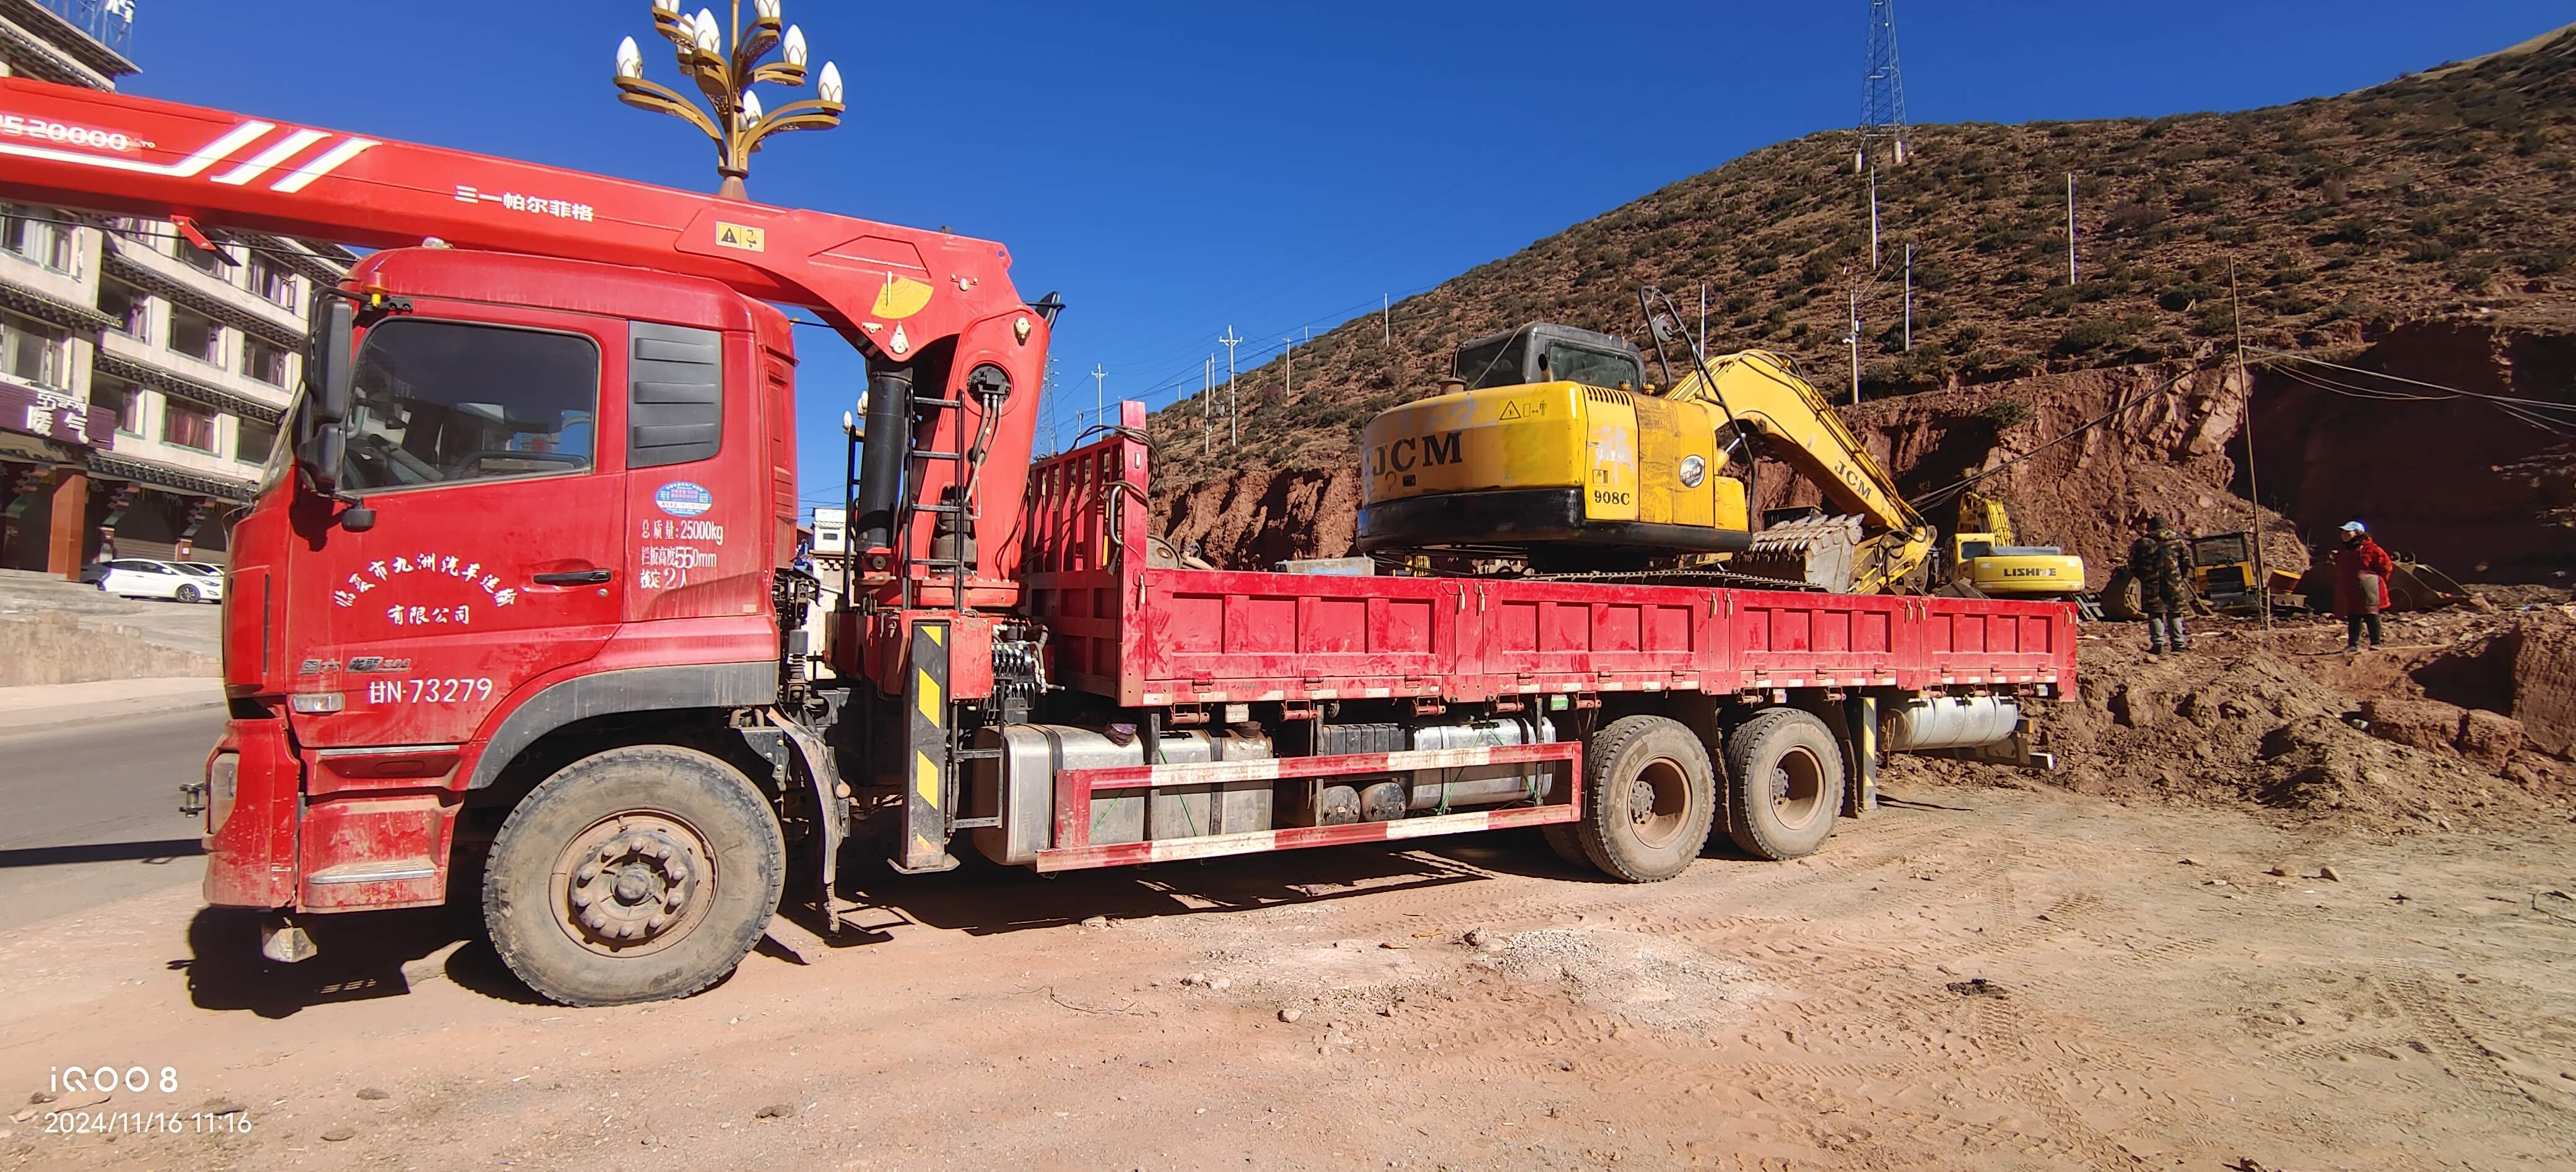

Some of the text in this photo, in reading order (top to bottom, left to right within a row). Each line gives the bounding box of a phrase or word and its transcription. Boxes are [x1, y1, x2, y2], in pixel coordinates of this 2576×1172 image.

[455, 185, 594, 222] 三一帕尔菲格
[1372, 429, 1463, 476] JCM
[1594, 490, 1630, 505] 908C
[1834, 460, 1871, 501] JCM
[333, 553, 518, 607] 临夏市九洲汽车运输
[2004, 568, 2056, 577] LISHIE
[388, 604, 470, 625] 有限公司
